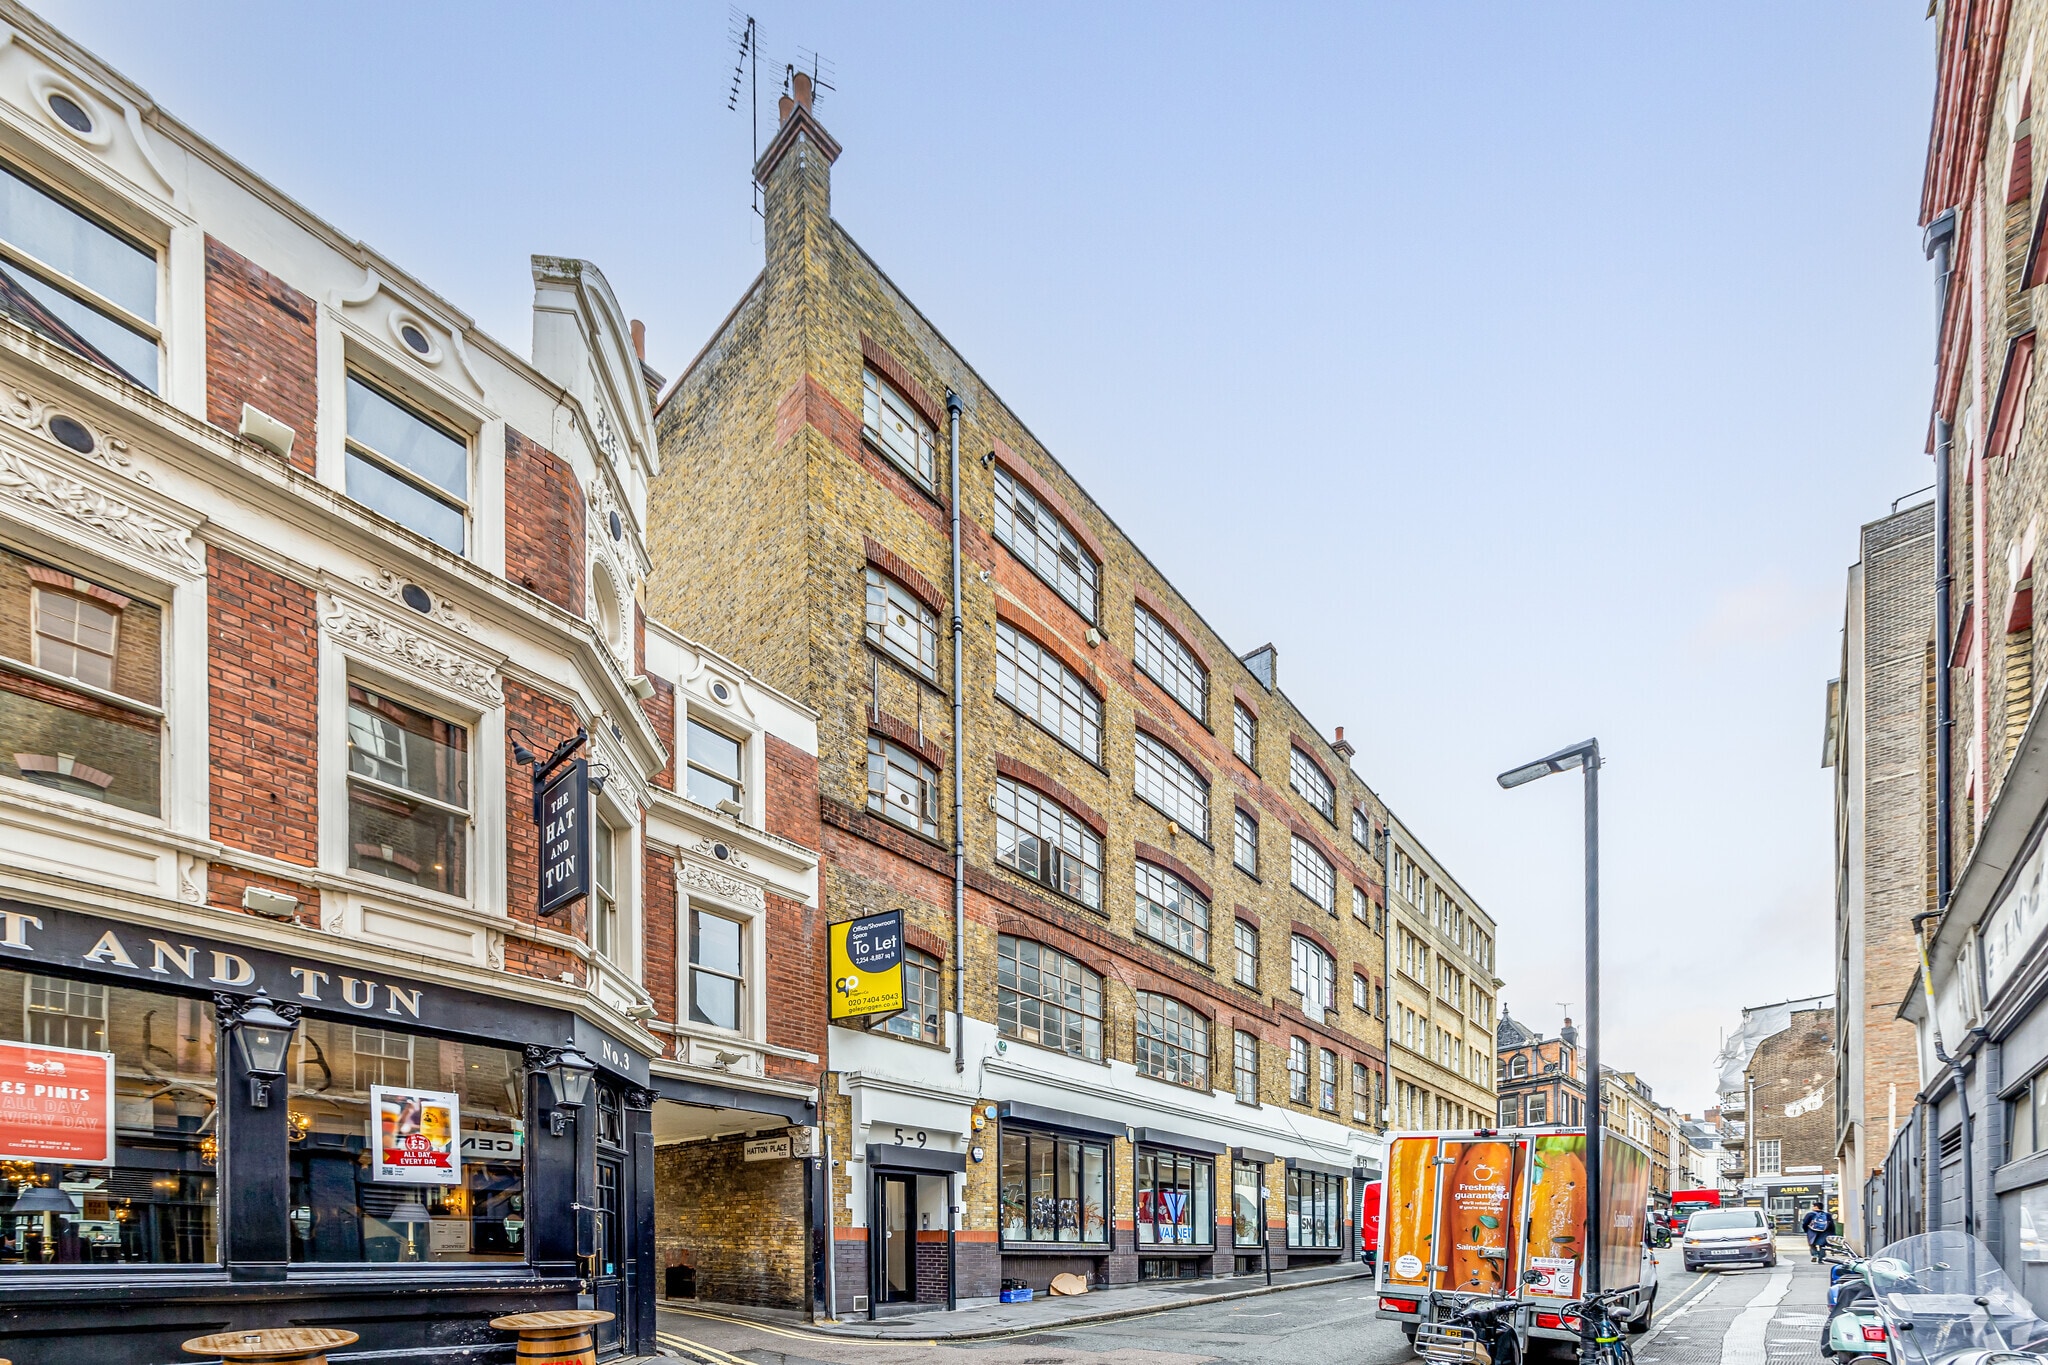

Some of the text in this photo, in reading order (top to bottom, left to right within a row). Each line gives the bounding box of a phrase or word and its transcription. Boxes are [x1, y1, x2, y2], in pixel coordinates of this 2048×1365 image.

[551, 792, 569, 814] THE
[546, 807, 575, 844] HAT
[551, 839, 569, 860] AND
[546, 855, 575, 888] TUN
[852, 920, 896, 932] Office/Showroom
[852, 932, 868, 940] Space
[853, 934, 897, 955] To Let
[83, 929, 256, 987] AND
[290, 966, 424, 1018] TUN
[862, 996, 880, 1004] 7404
[881, 993, 899, 1001] 5043
[602, 1039, 630, 1071] No.3
[0, 1081, 90, 1101] £5 PINTS
[3, 1096, 37, 1111] ALL
[62, 1116, 98, 1130] DAY
[411, 1139, 425, 1150] £5
[893, 1128, 927, 1149] 5-9
[746, 1144, 787, 1155] HATTON PLACE
[1459, 1183, 1506, 1191] Freshness
[1454, 1191, 1510, 1201] guaranteed
[1301, 1217, 1326, 1231] SNCK
